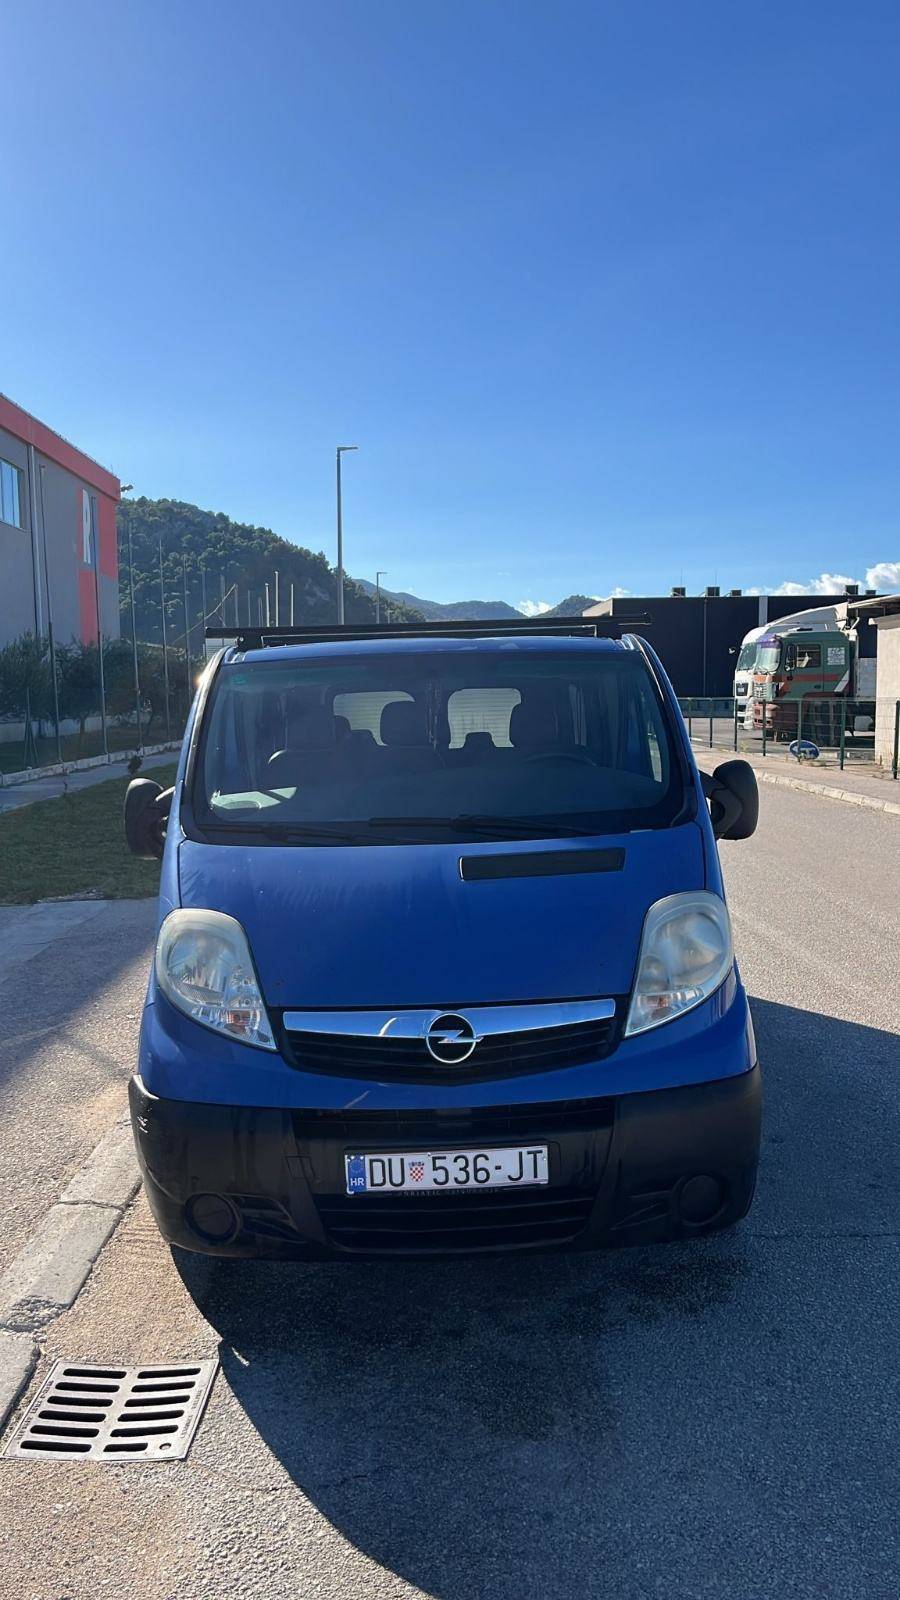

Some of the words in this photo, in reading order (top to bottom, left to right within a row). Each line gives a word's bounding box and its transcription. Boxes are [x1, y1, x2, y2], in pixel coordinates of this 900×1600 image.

[369, 1158, 405, 1187] DU
[431, 1150, 543, 1185] 536-JT
[350, 1177, 364, 1186] HR
